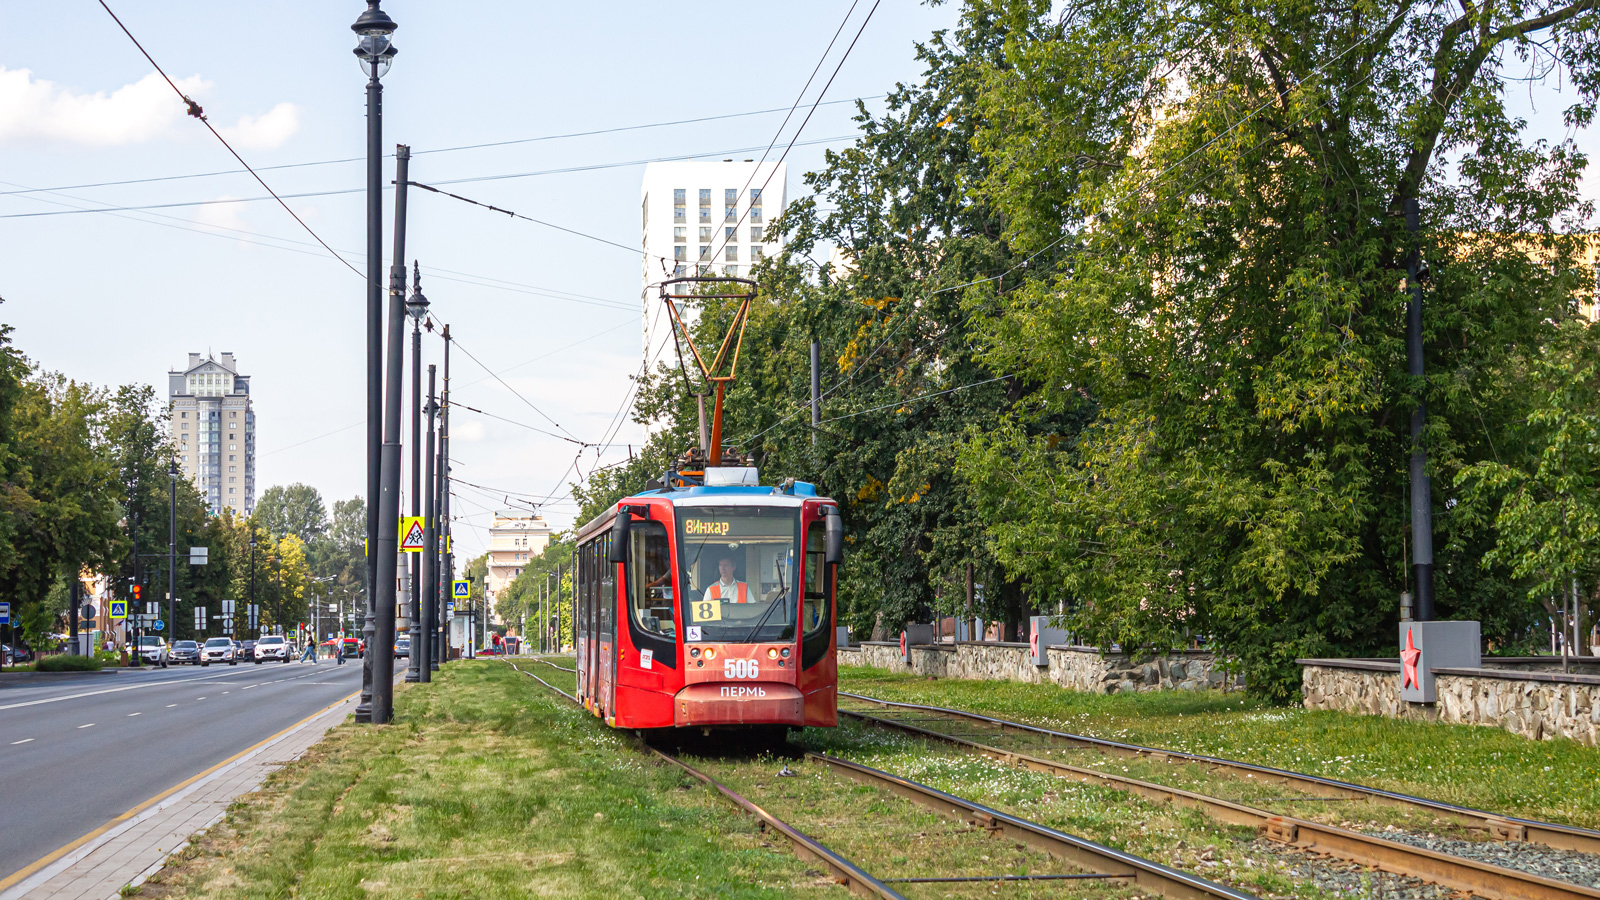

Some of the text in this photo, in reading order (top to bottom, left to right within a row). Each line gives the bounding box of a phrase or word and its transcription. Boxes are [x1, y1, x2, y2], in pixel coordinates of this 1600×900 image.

[699, 602, 714, 619] 8
[724, 658, 759, 679] 506
[720, 686, 766, 697] ПЕРМЬ
